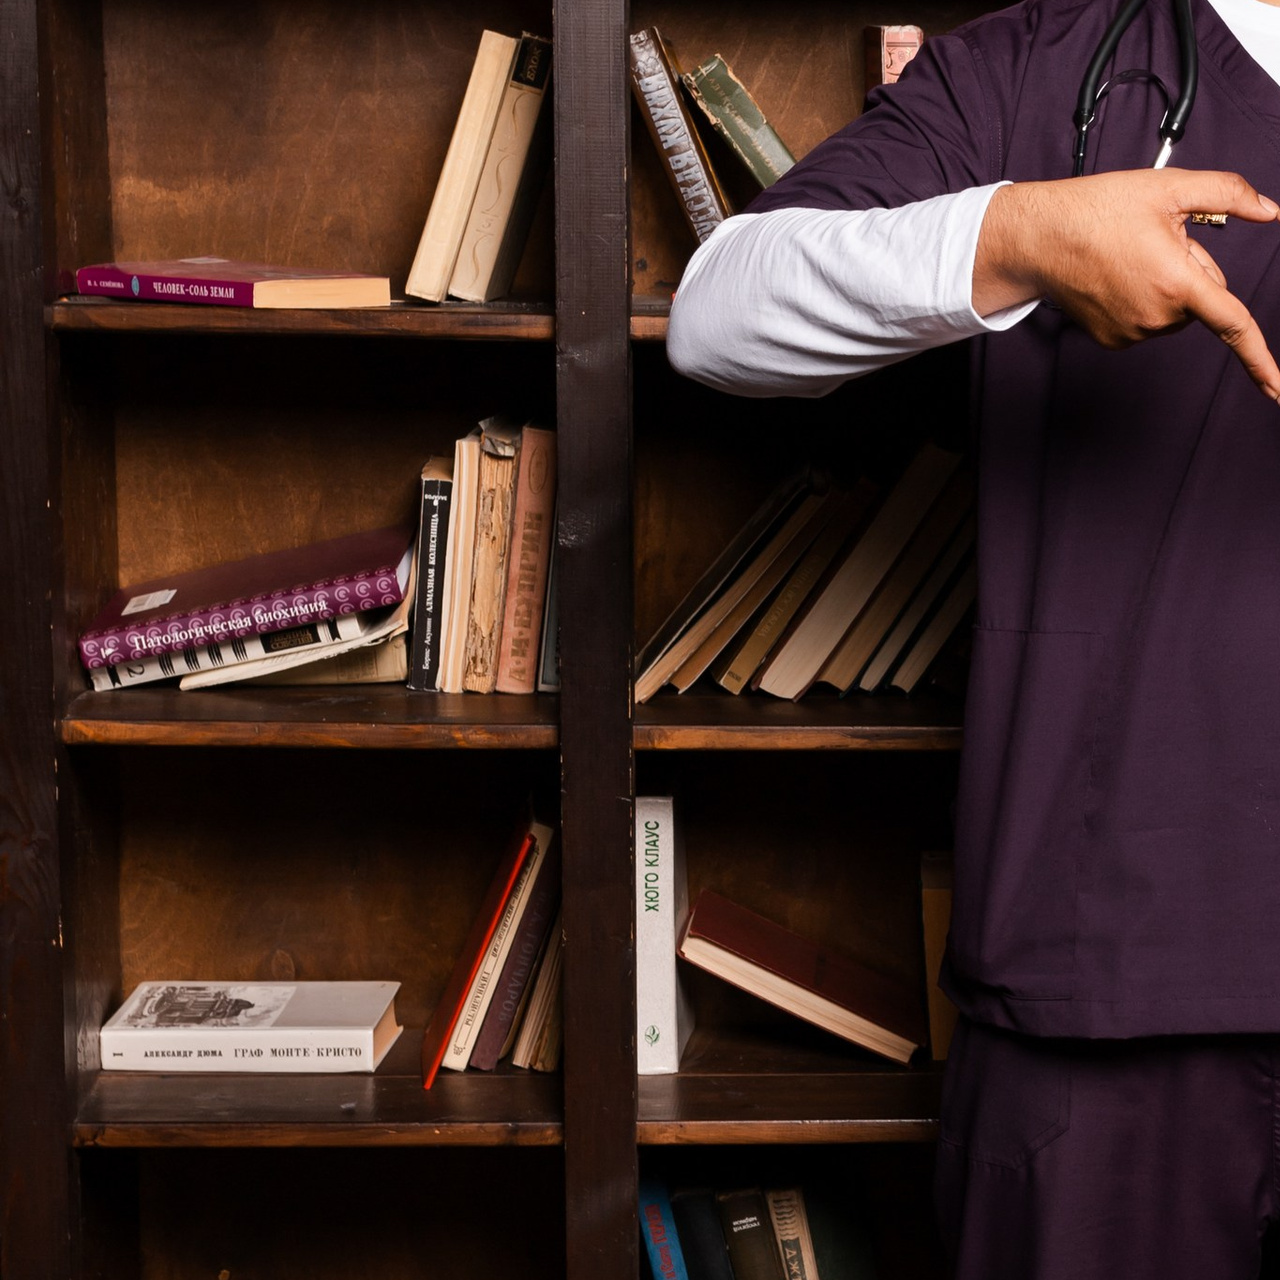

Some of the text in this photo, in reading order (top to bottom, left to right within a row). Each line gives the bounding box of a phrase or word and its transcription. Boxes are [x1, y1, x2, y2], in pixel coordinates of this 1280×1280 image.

[524, 45, 543, 81] БЛОК
[636, 70, 689, 150] КУХНЯ
[209, 285, 235, 299] ЗЕМЛИ
[132, 611, 253, 652] Патологическая
[252, 594, 329, 625] биохимия
[421, 513, 440, 670] Борис Акунин АЛМАЗНАЯ КОЛЕСНИЦА
[644, 820, 659, 911] ХЮГО КЛАУС
[496, 930, 539, 1025] ГОНЧАРОВ
[143, 1049, 193, 1058] АЛЕКСАНДР
[196, 1049, 223, 1058] ДЮМА
[232, 1047, 264, 1058] ГРАФ
